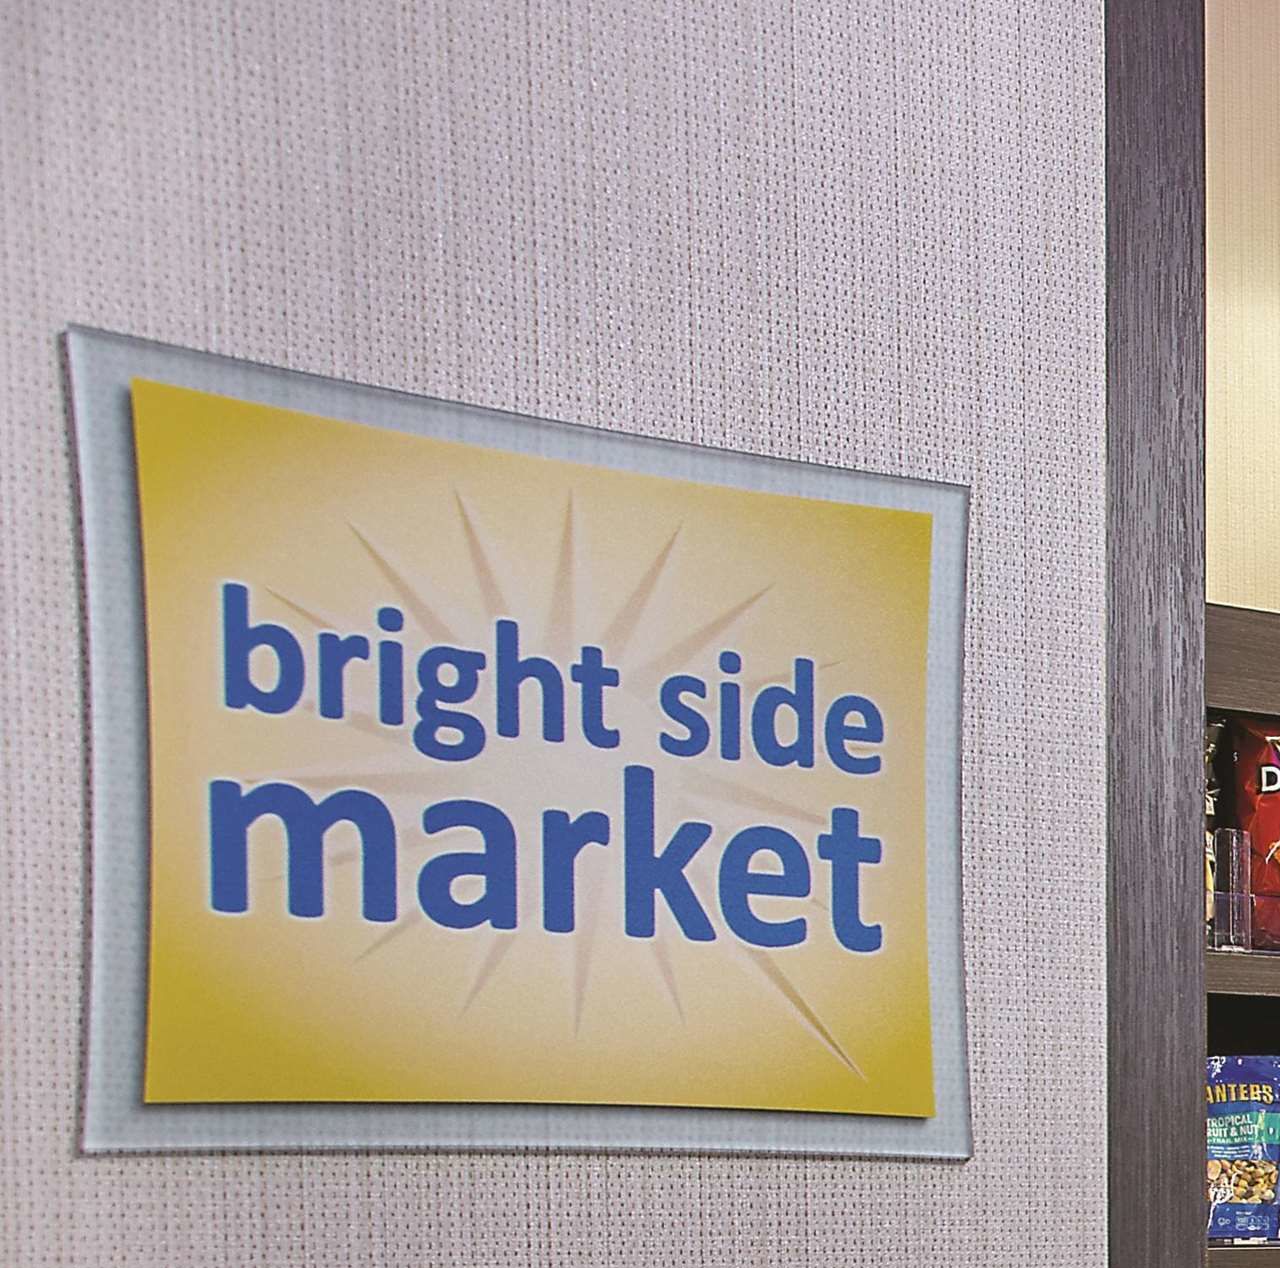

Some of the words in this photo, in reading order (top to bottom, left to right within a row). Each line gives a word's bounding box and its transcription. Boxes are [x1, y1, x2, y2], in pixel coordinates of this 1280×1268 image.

[221, 582, 620, 762] bright
[658, 650, 885, 775] side
[208, 765, 884, 954] market
[1207, 1083, 1275, 1105] ANTERS
[1207, 1125, 1228, 1138] RUIT
